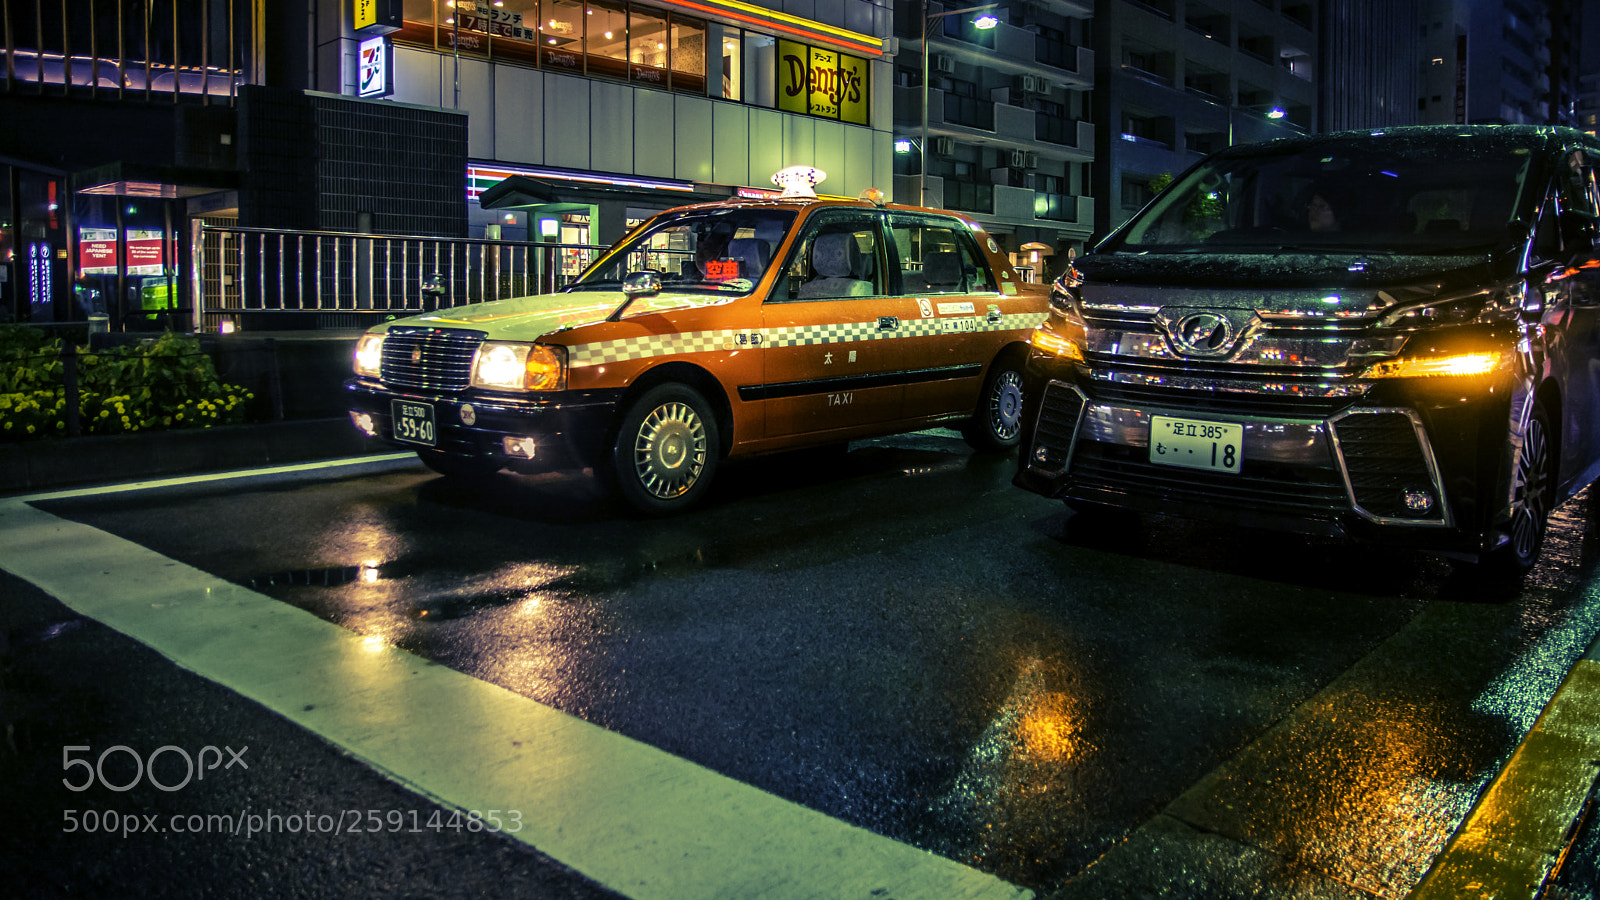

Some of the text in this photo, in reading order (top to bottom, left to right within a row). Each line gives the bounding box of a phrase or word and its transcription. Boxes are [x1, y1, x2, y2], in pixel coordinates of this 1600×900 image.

[815, 53, 833, 63] デニーズ
[783, 54, 862, 106] Denny's
[809, 104, 838, 115] レストラン
[827, 392, 853, 407] TAXI
[414, 406, 425, 418] 500
[402, 417, 433, 441] 59-60
[1173, 422, 1223, 440] 足立 385
